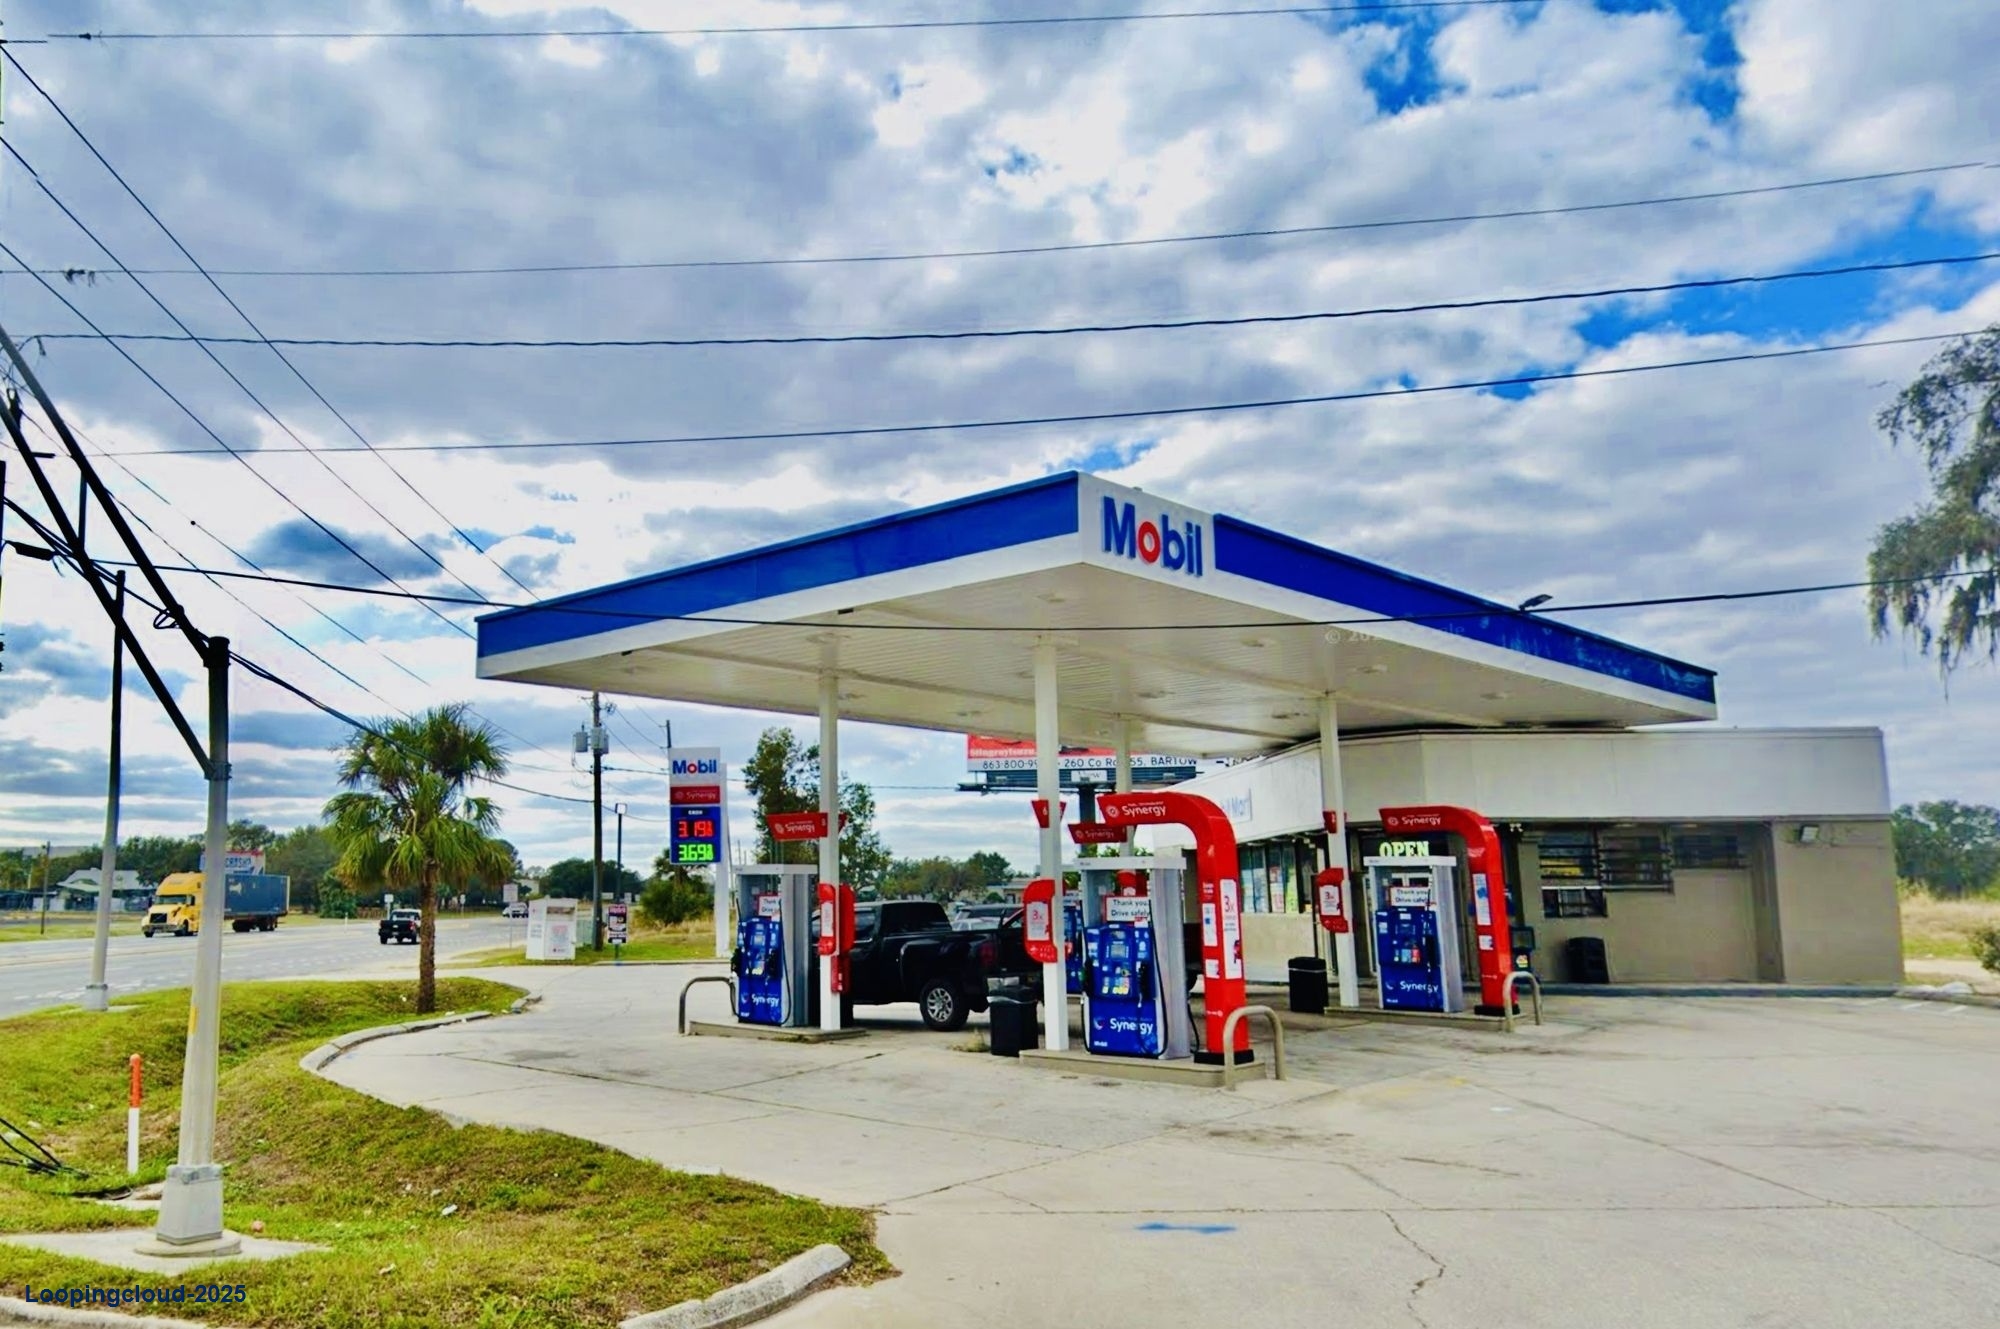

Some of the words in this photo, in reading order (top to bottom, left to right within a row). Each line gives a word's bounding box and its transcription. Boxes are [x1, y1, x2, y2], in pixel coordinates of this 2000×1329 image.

[1103, 495, 1203, 577] Mobil
[672, 759, 717, 775] Mobil
[1064, 759, 1084, 768] 260
[1088, 759, 1101, 767] Co
[686, 791, 716, 800] Synergy
[1121, 805, 1166, 818] Synergy
[1401, 815, 1441, 826] Synergy
[785, 823, 815, 833] Synergy
[1085, 830, 1114, 839] Synergy
[1379, 840, 1430, 857] OPEN
[1111, 909, 1129, 917] Drive
[1109, 1017, 1153, 1035] Synegy
